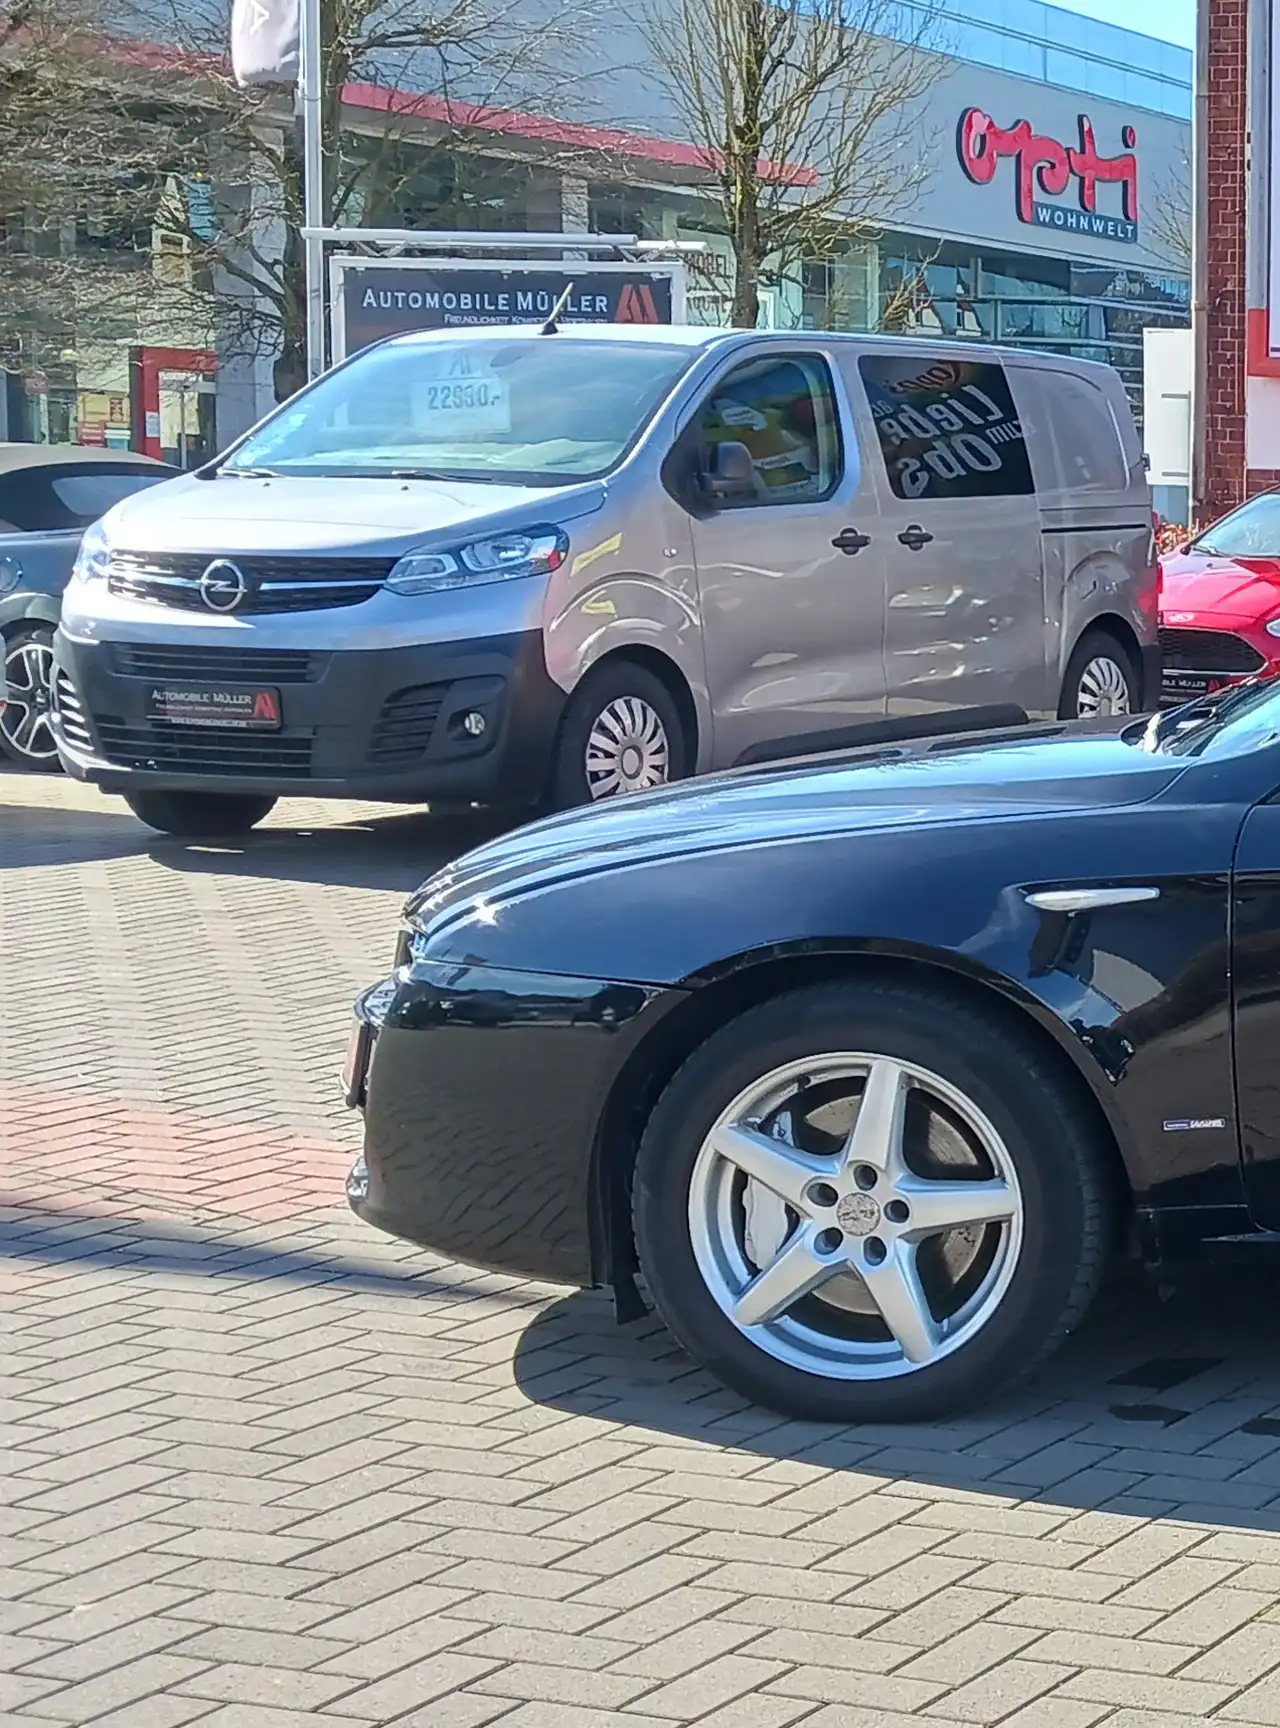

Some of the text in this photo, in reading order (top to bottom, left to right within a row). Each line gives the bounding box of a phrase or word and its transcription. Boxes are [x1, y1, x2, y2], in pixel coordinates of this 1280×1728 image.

[956, 107, 1138, 224] opti
[1036, 206, 1135, 238] WOHNWELT
[362, 288, 509, 311] AUTOMOBILE
